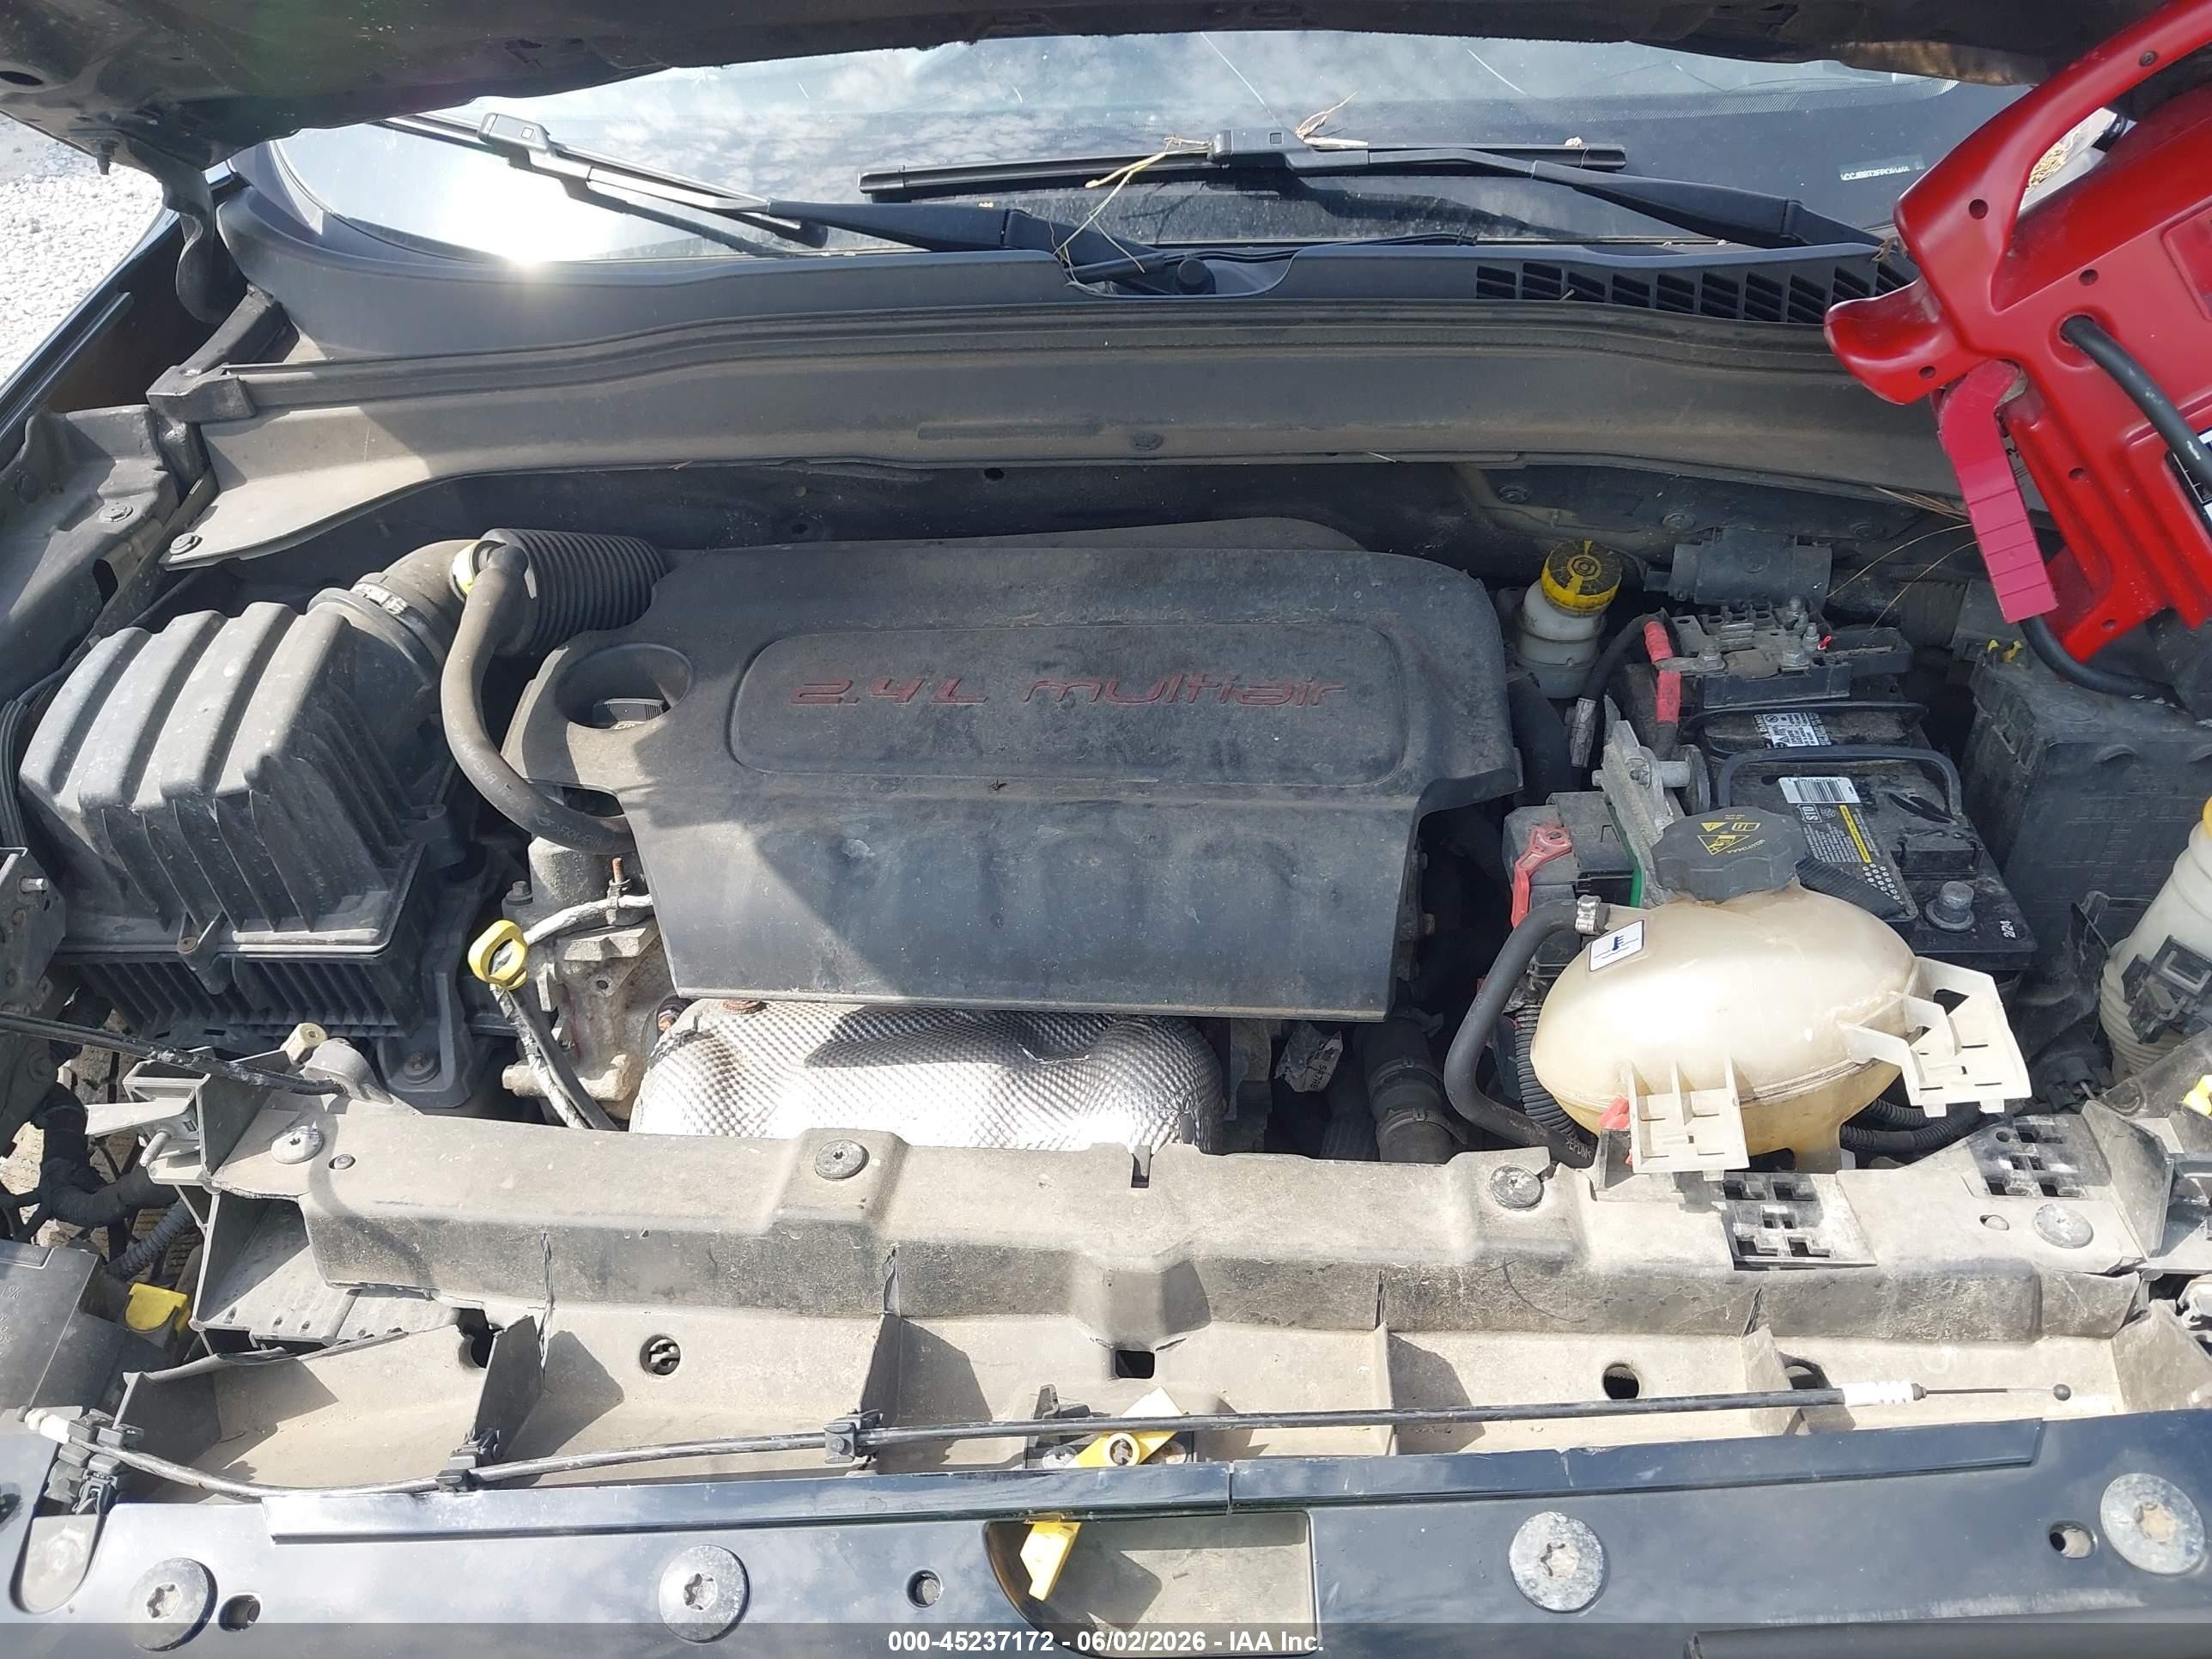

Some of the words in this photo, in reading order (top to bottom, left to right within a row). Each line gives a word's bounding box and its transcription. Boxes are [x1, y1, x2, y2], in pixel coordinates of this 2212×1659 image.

[788, 677, 990, 705] 2.4L
[1022, 672, 1346, 706] multiair
[1999, 920, 2016, 939] 2/24
